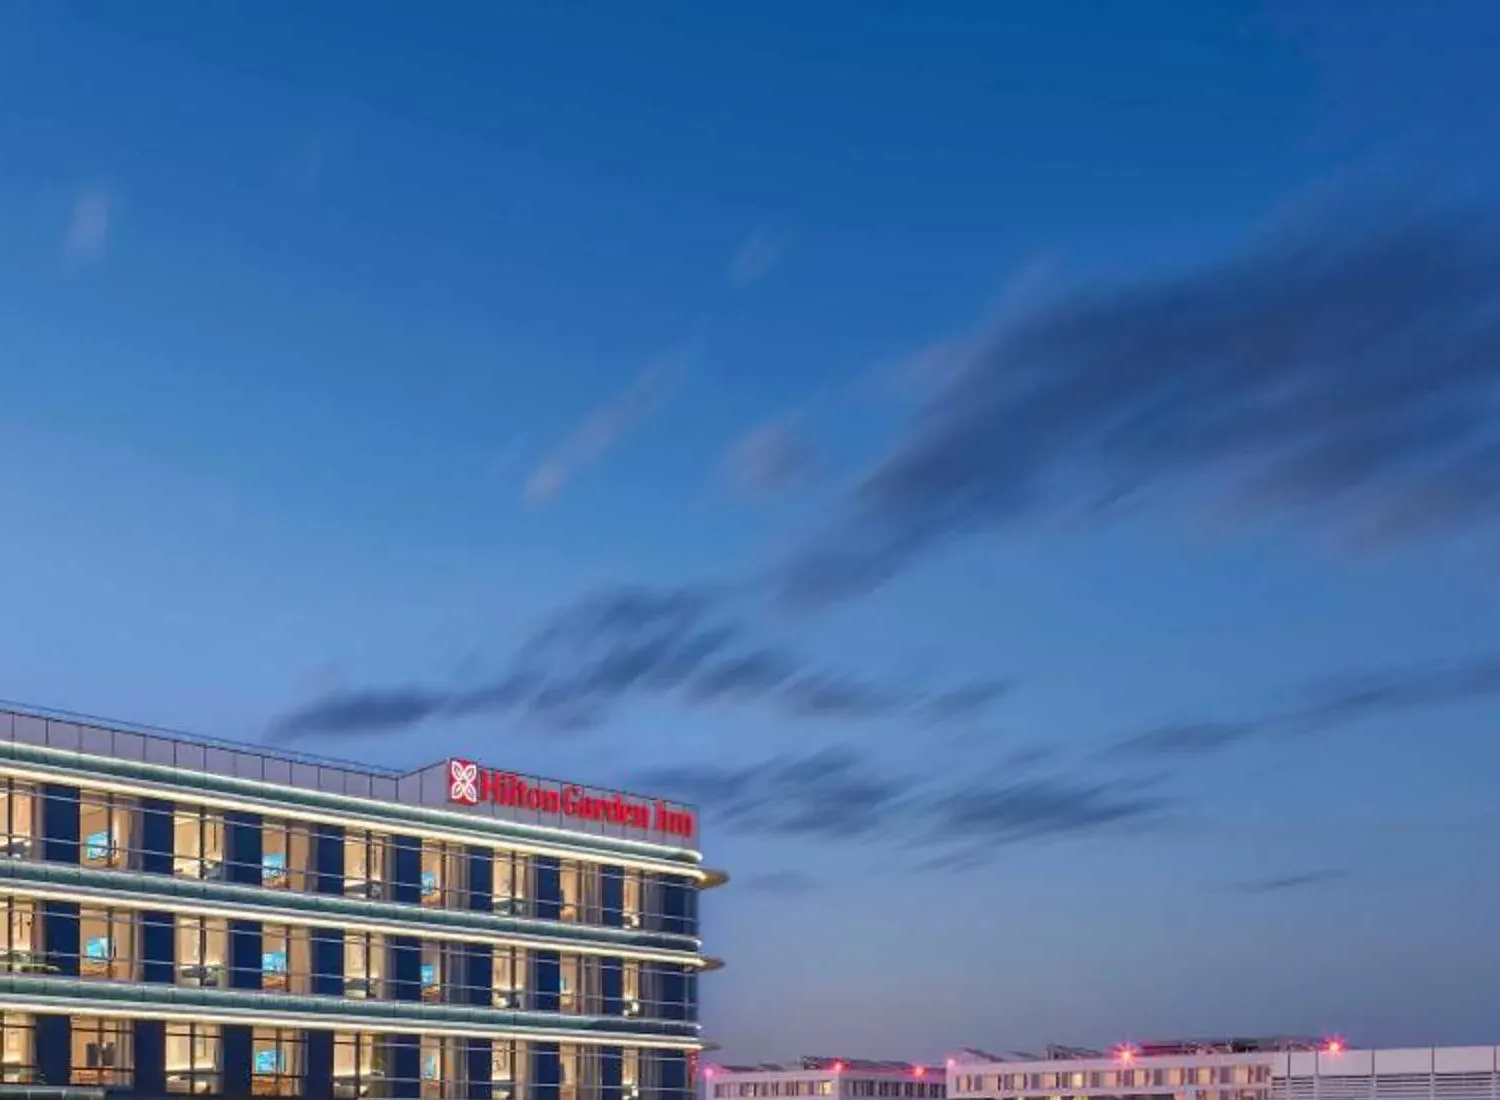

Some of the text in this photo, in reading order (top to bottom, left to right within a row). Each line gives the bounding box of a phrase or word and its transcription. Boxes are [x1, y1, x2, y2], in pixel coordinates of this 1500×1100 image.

[479, 769, 694, 838] Hilton Garden Inn
